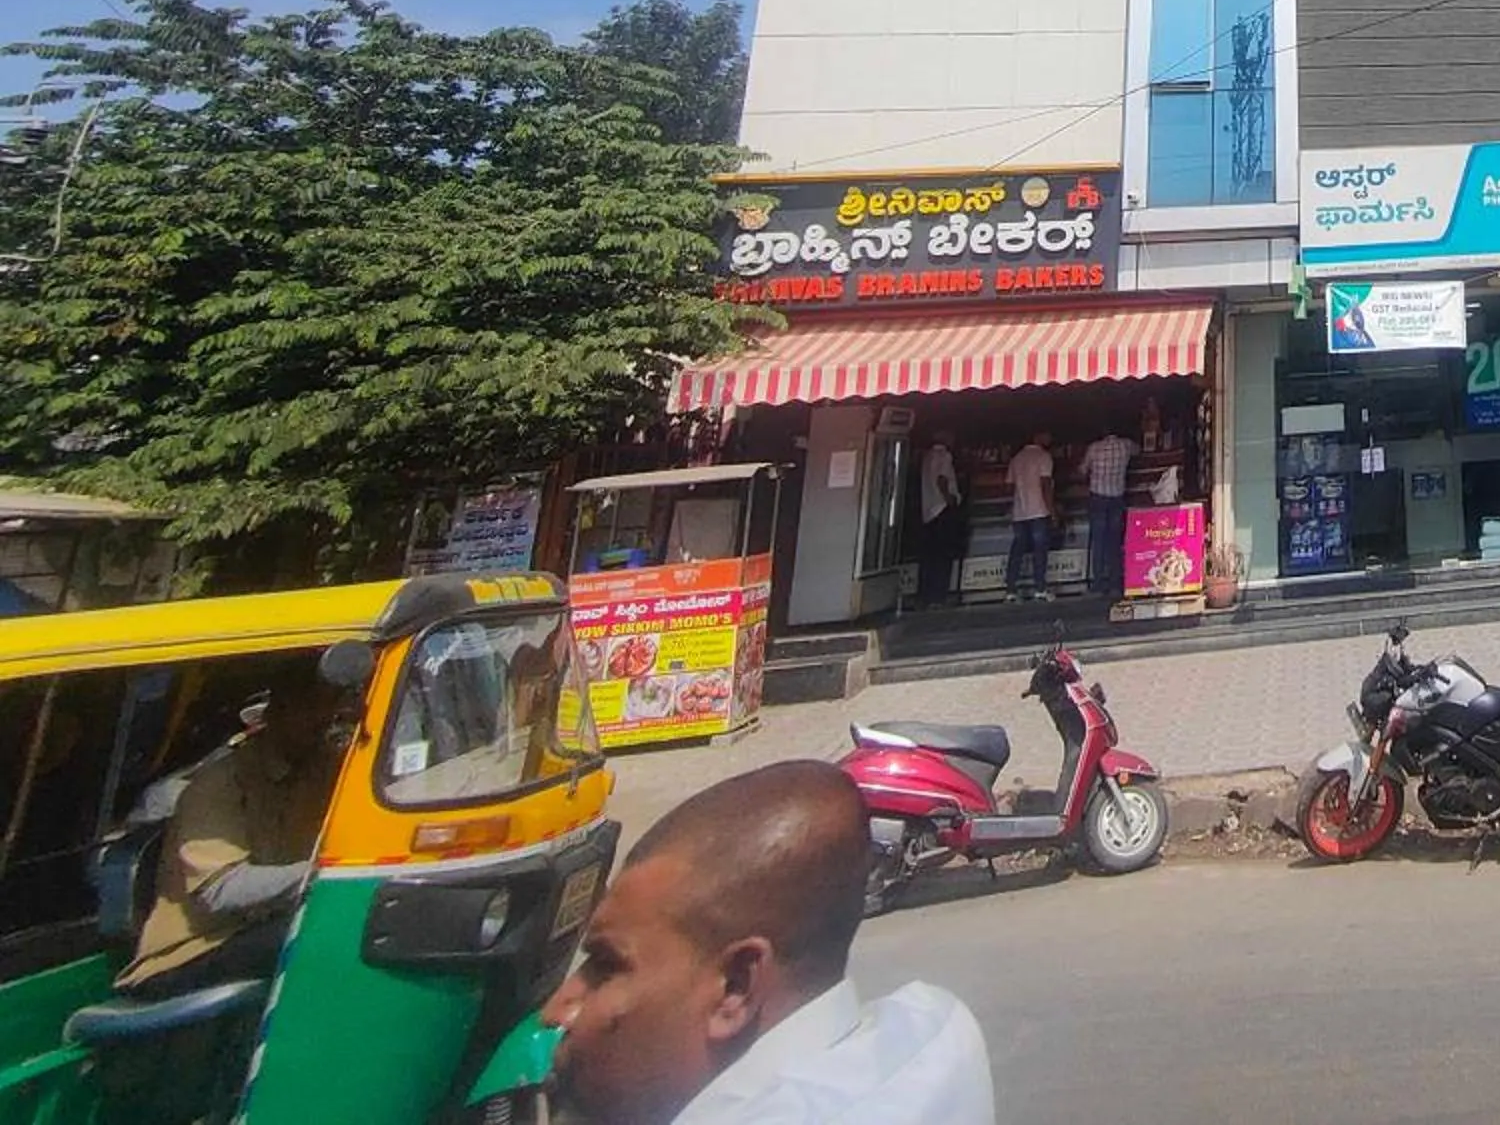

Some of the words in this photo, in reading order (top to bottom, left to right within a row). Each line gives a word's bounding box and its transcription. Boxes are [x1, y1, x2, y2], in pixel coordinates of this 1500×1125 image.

[1315, 162, 1397, 200] ಆಸ್ಟರ್
[857, 268, 984, 296] BRAMINS
[996, 264, 1105, 290] BAKERS
